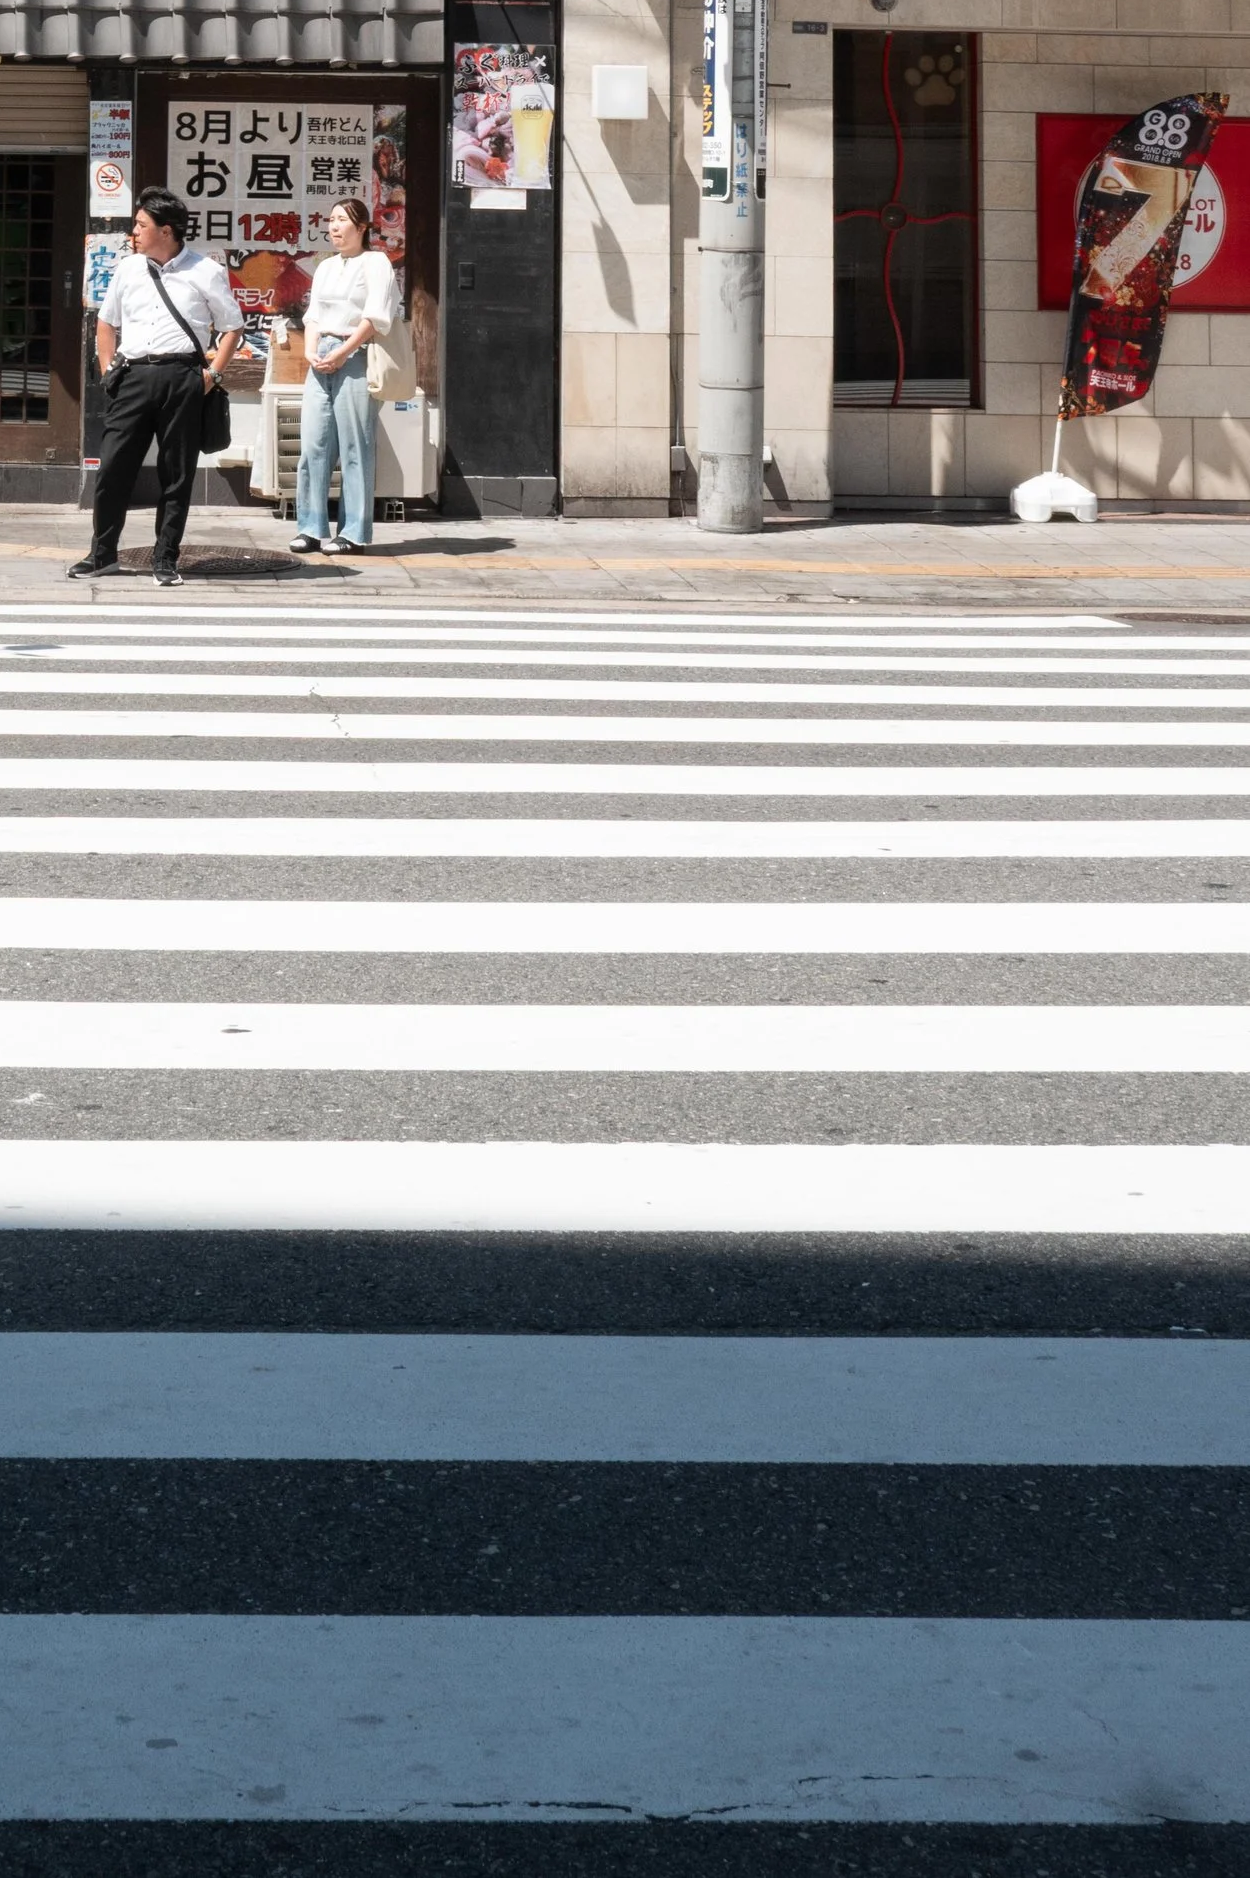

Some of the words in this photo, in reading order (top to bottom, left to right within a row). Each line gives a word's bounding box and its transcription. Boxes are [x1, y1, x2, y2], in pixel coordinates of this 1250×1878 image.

[175, 109, 303, 145] 8月より
[308, 117, 367, 133] 吾作どん
[308, 135, 367, 145] 天王寺北口店
[1134, 144, 1161, 155] GRAND
[1162, 148, 1182, 159] OPEN
[186, 151, 294, 199] お昼
[311, 157, 362, 183] 営業
[736, 123, 748, 218] はり紙禁止
[306, 185, 367, 197] 再開します!
[238, 211, 302, 243] 12時
